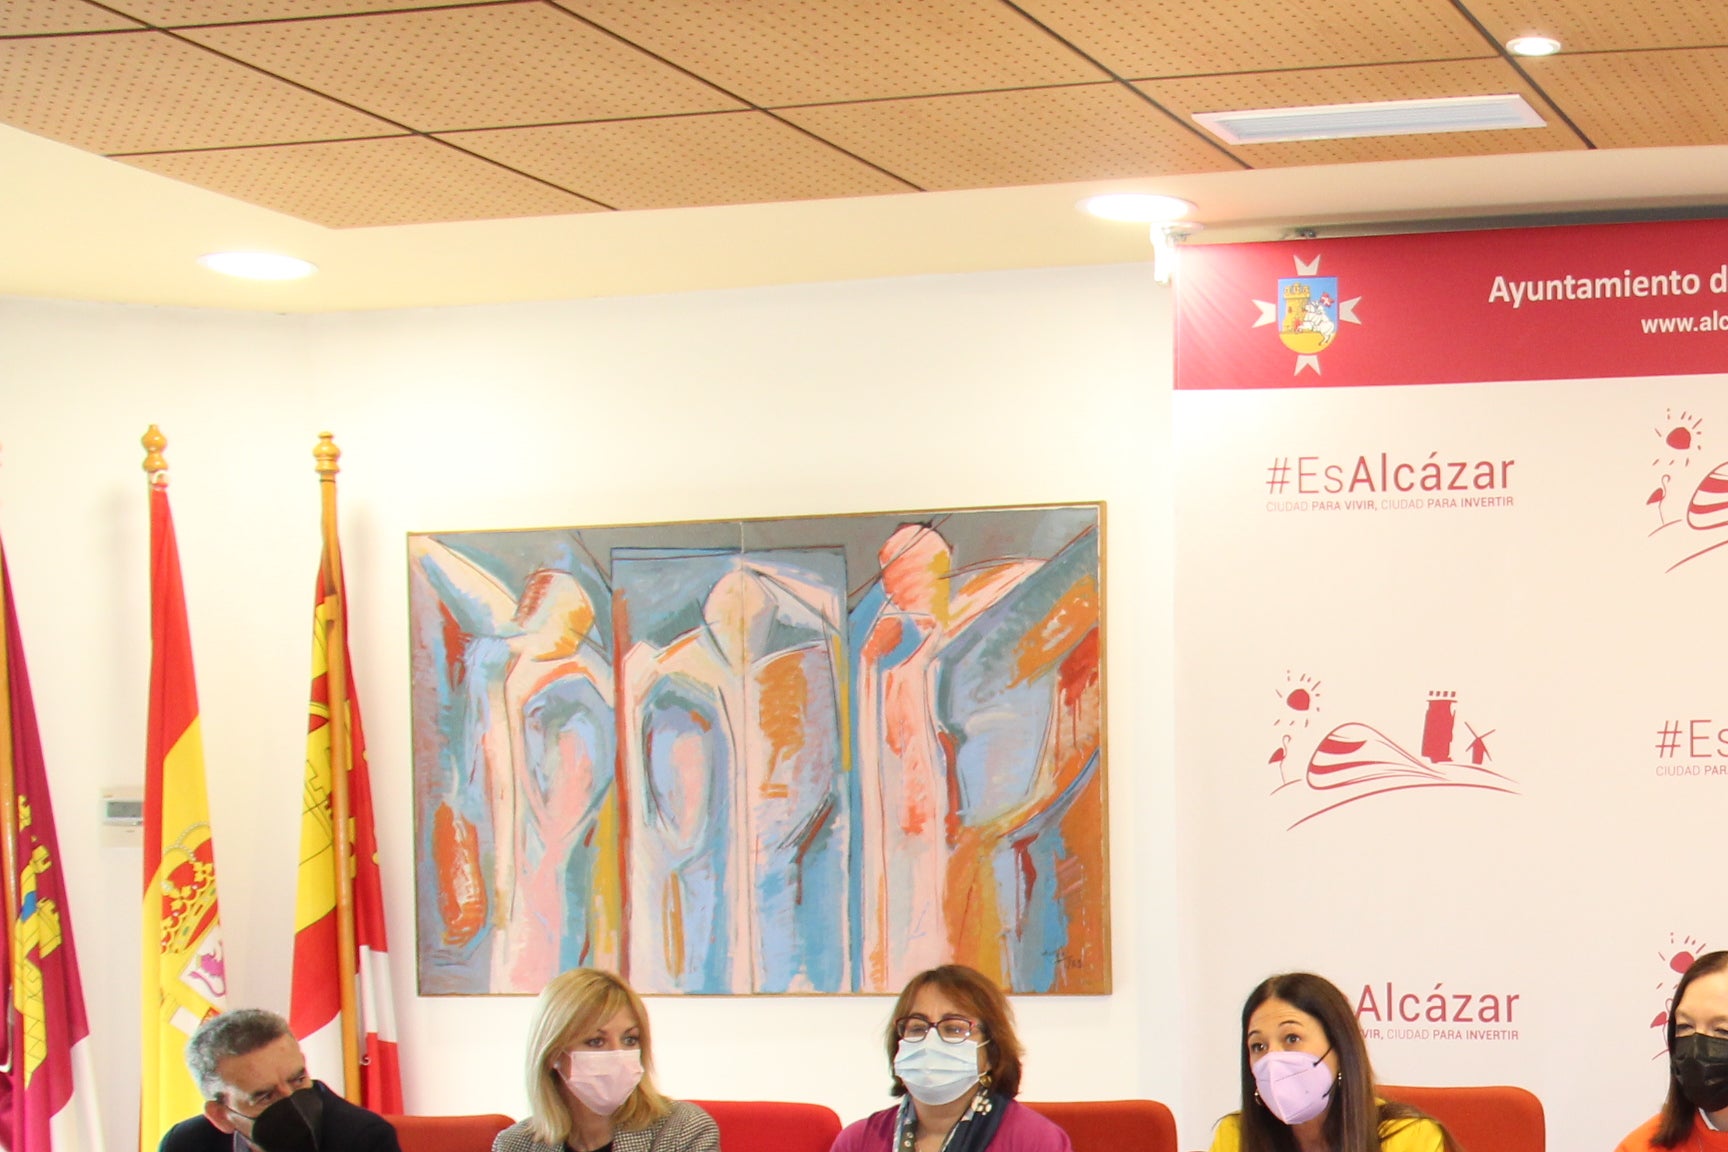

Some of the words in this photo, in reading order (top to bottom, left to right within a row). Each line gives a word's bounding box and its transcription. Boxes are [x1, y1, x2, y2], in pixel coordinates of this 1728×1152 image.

[1487, 269, 1701, 309] Ayuntamiento
[1265, 451, 1515, 495] #EsAlcázar
[1265, 501, 1309, 513] CIUDAD
[1311, 500, 1342, 512] PARA
[1345, 499, 1378, 512] VIVIR,
[1380, 498, 1424, 510] CIUDAD
[1426, 497, 1458, 509] PARA
[1460, 496, 1515, 508] INVERTIR
[1655, 765, 1702, 777] CIUDAD
[1355, 981, 1520, 1023] Alcázar
[1386, 1028, 1430, 1040] CIUDAD
[1432, 1029, 1463, 1040] PARA
[1465, 1029, 1520, 1041] INVERTIR
